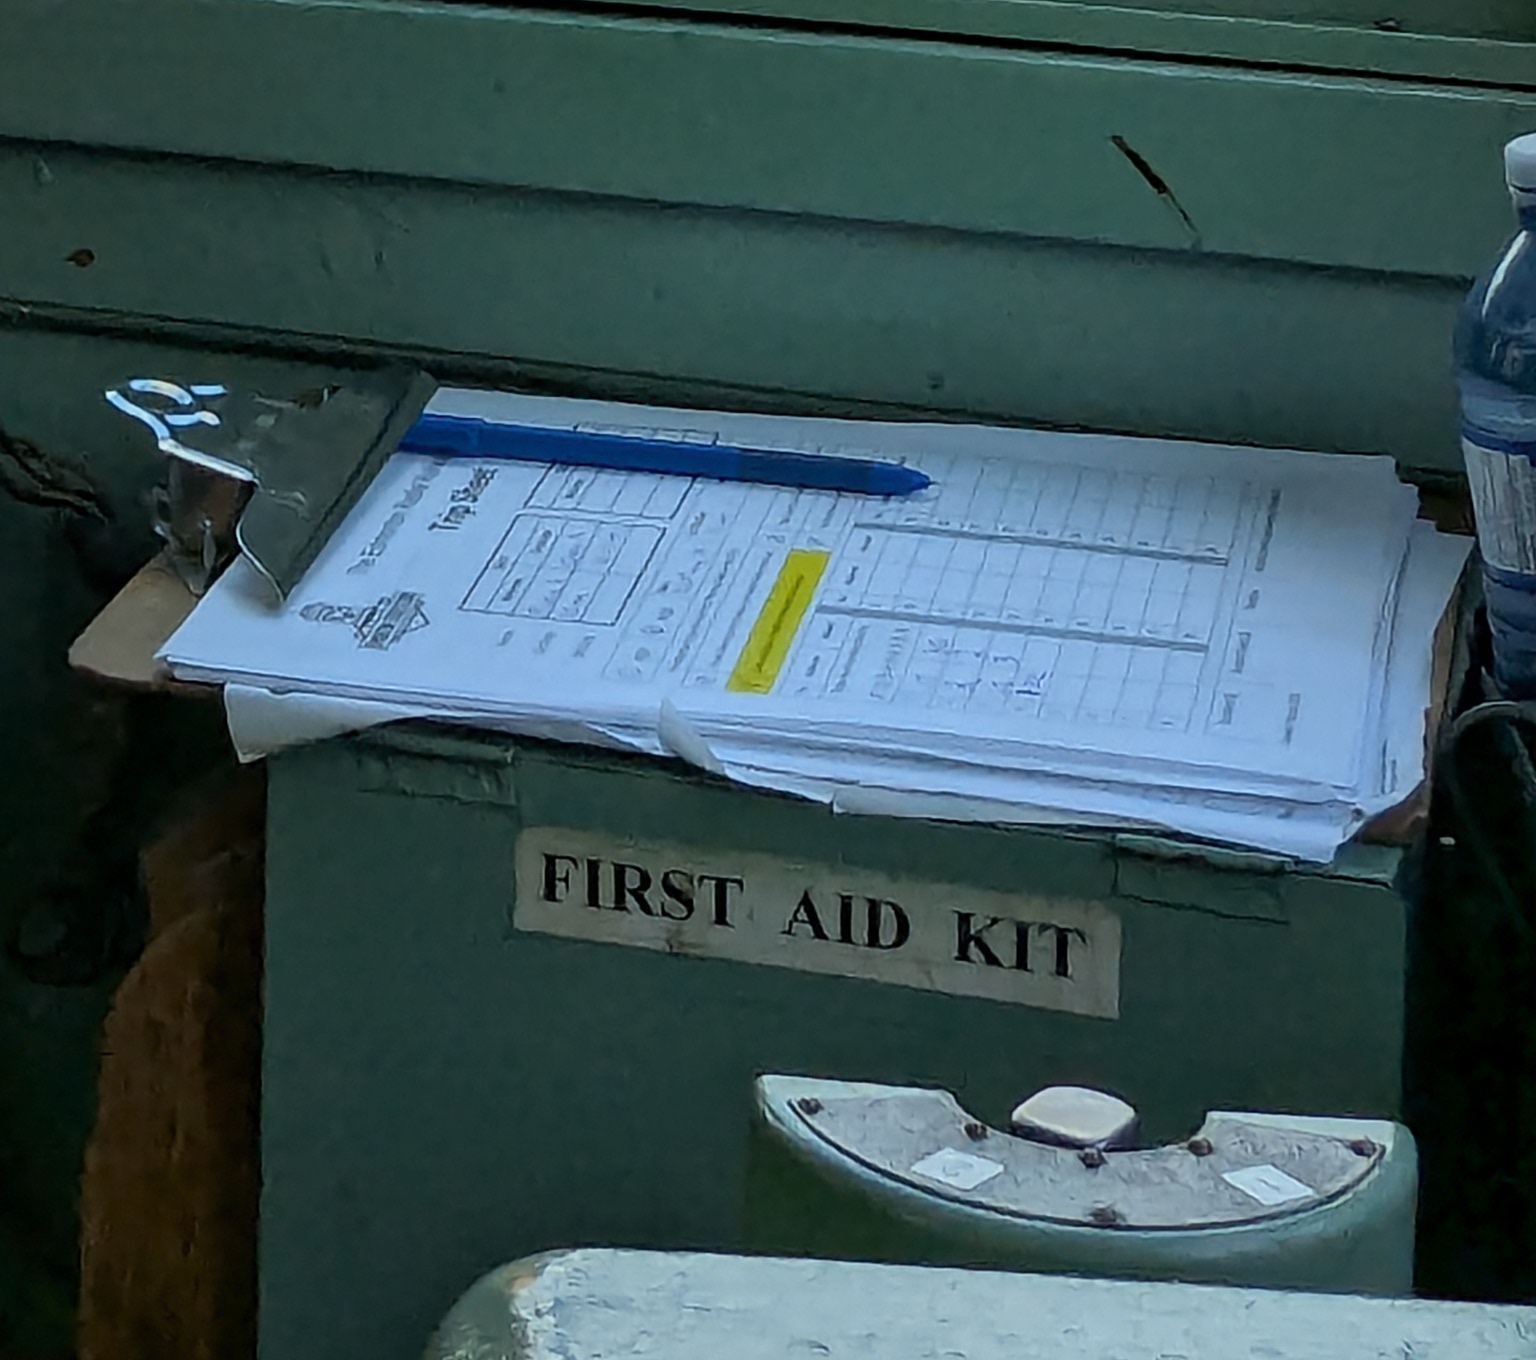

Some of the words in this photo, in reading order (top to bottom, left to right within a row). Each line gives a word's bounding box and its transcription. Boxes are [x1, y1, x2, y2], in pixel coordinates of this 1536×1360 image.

[542, 852, 745, 929] FIRST
[780, 888, 911, 950] AID
[951, 908, 1089, 978] KIT
